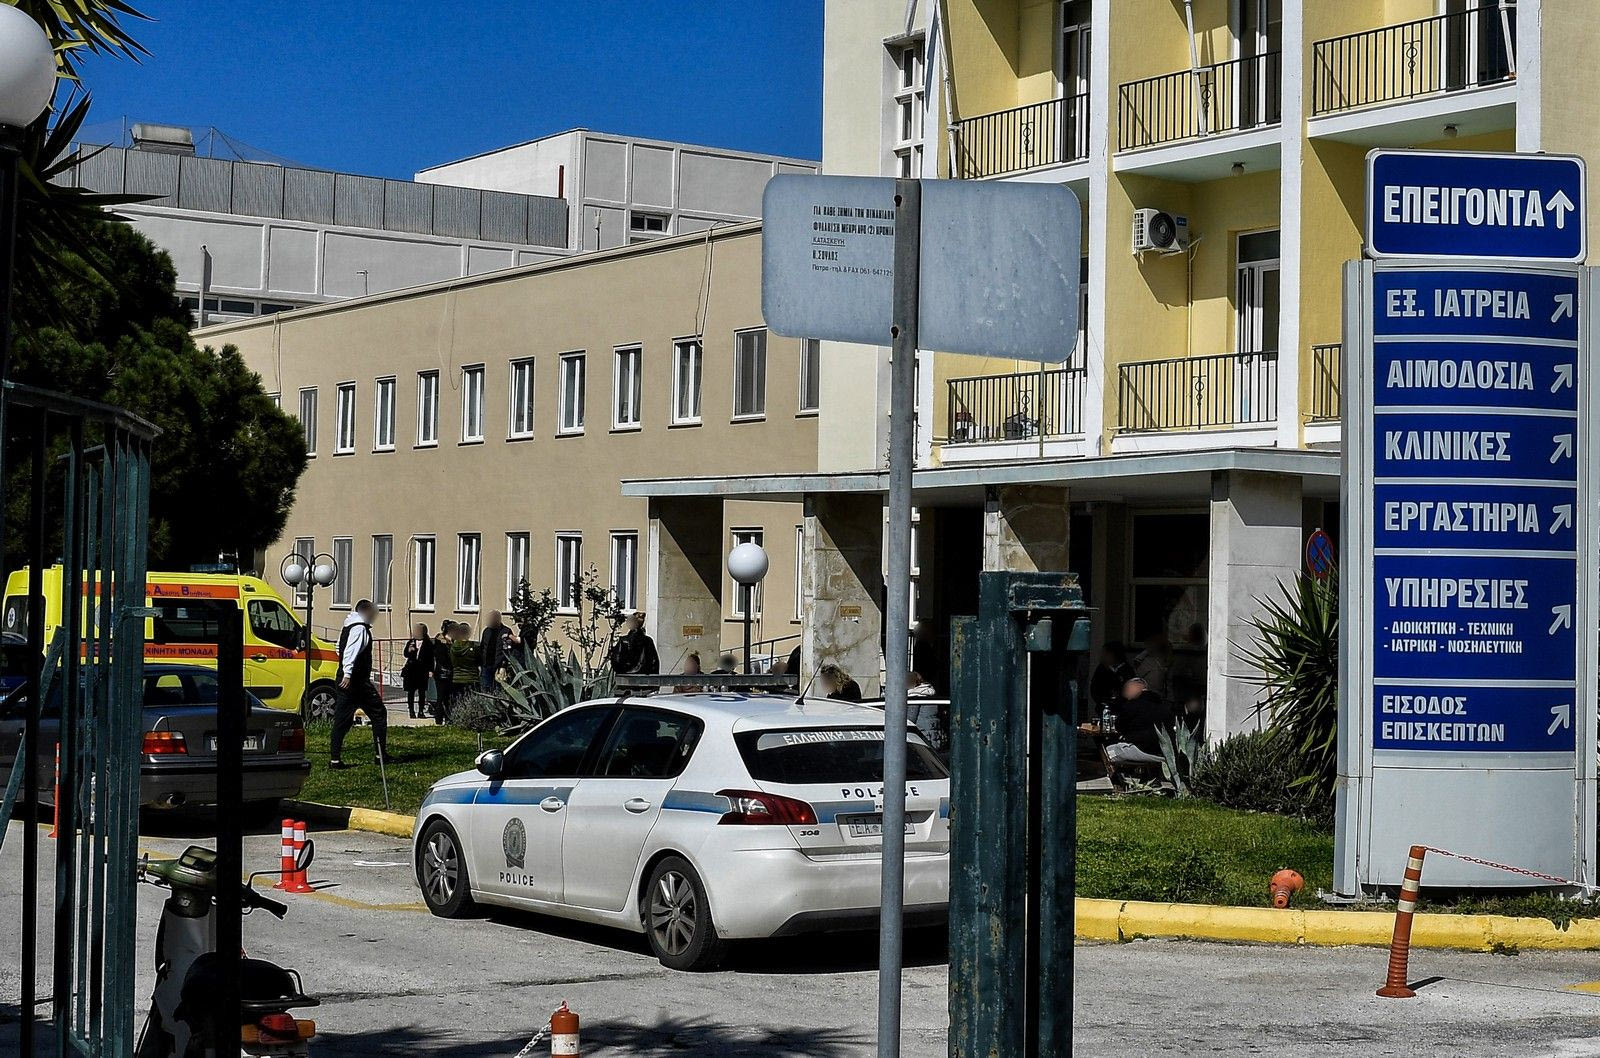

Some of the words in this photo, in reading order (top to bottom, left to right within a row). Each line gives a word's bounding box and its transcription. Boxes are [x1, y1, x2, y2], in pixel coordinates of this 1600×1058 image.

[813, 205, 821, 216] ΓΙΑ
[1384, 185, 1544, 227] ΕΠΕΙΓΟΝΤΑ
[1386, 289, 1425, 318] ΕΞ.
[1434, 289, 1531, 320] ΙΑΤΡΕΙΑ
[1386, 359, 1534, 391] ΑΙΜΟΔΟΣΙΑ
[1385, 430, 1511, 462] ΚΛΙΝΙΚΕΣ
[1384, 501, 1540, 533] ΕΡΓΑΣΤΗΡΙΑ
[1384, 577, 1529, 609] ΥΠΗΡΕΣΙΕΣ
[1391, 621, 1457, 635] ΔΙΟΙΚΗΤΙΚΗ
[1467, 622, 1514, 636] ΤΕΧΝΙΚΗ
[1391, 638, 1437, 653] ΙΑΤΡΙΚΗ
[1447, 639, 1523, 654] ΝΟΣΗΛΕΥΤΙΚΗ
[1382, 695, 1467, 715] ΕΙΣΟΔΟΣ
[1382, 721, 1505, 742] ΕΠΙΣΚΕΠΤΩΝ
[841, 786, 920, 799] POLE
[800, 829, 820, 837] 308
[499, 871, 534, 887] POLICE
